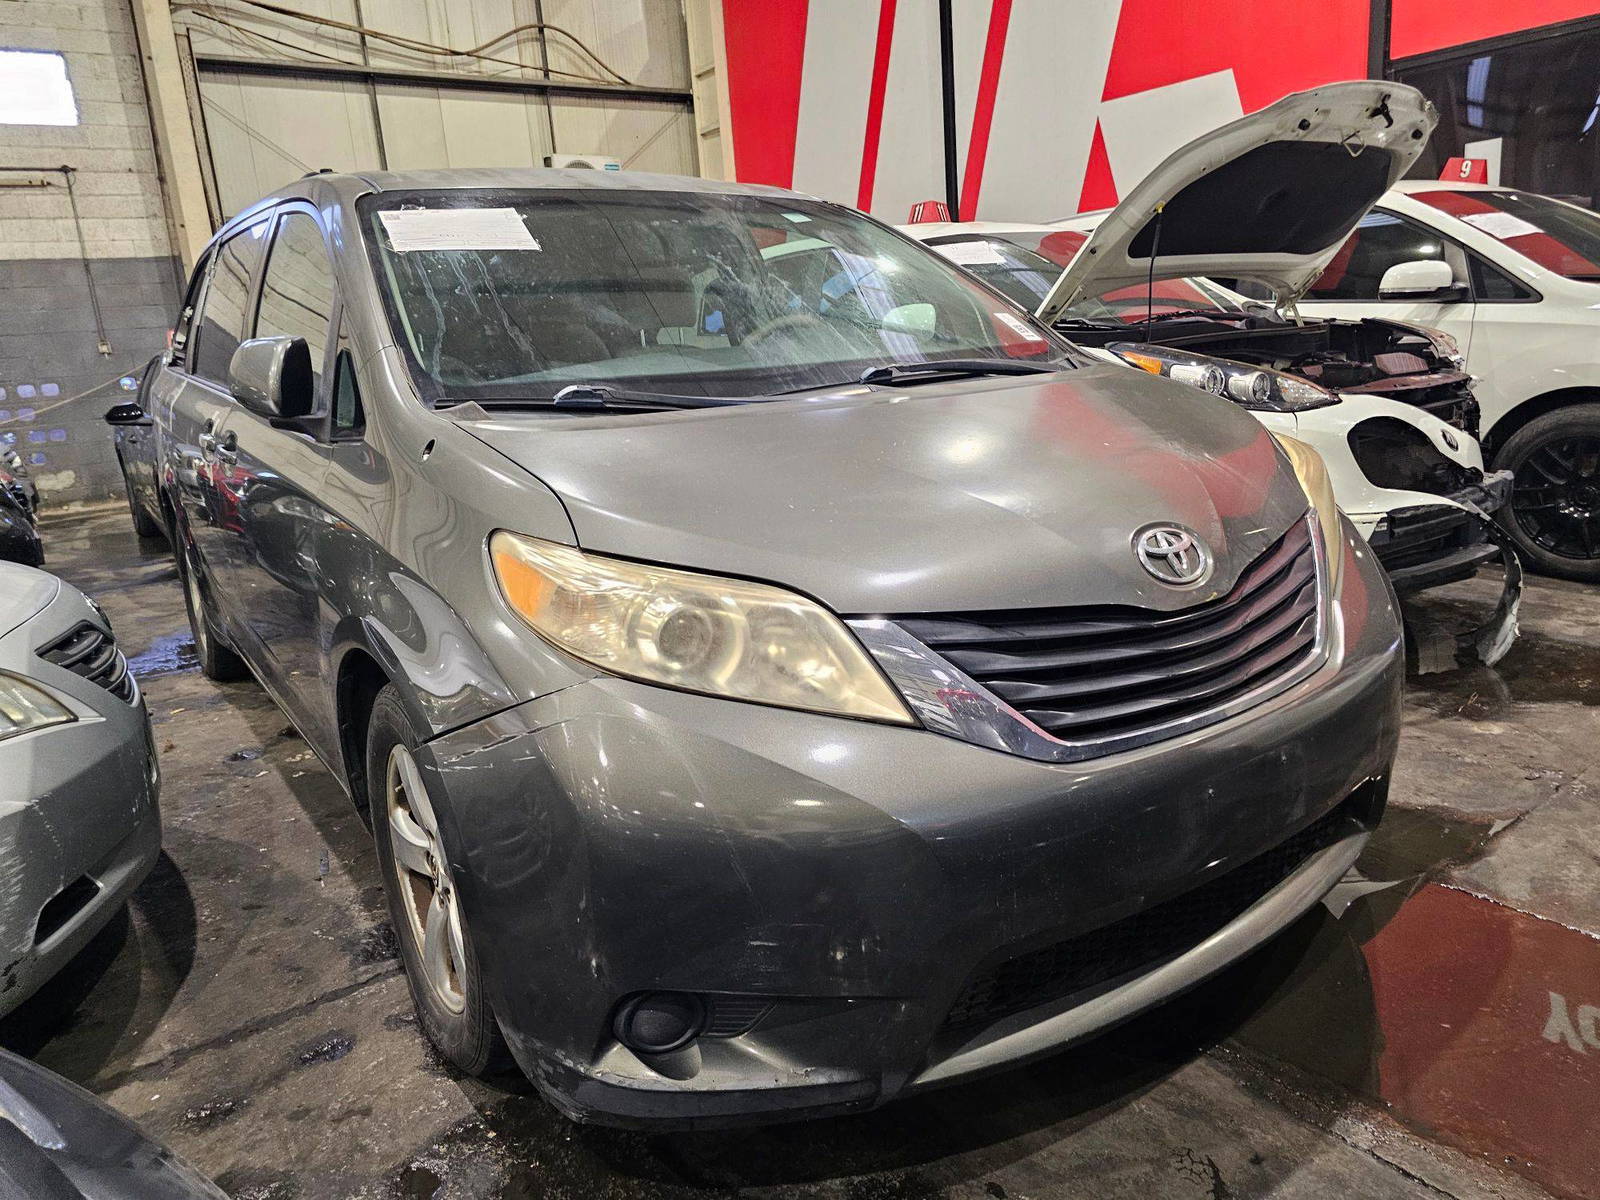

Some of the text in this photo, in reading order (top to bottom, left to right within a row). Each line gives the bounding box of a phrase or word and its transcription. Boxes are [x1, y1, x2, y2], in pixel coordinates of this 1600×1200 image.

[1460, 160, 1472, 178] 9
[913, 203, 924, 223] 11
[937, 203, 947, 222] 11
